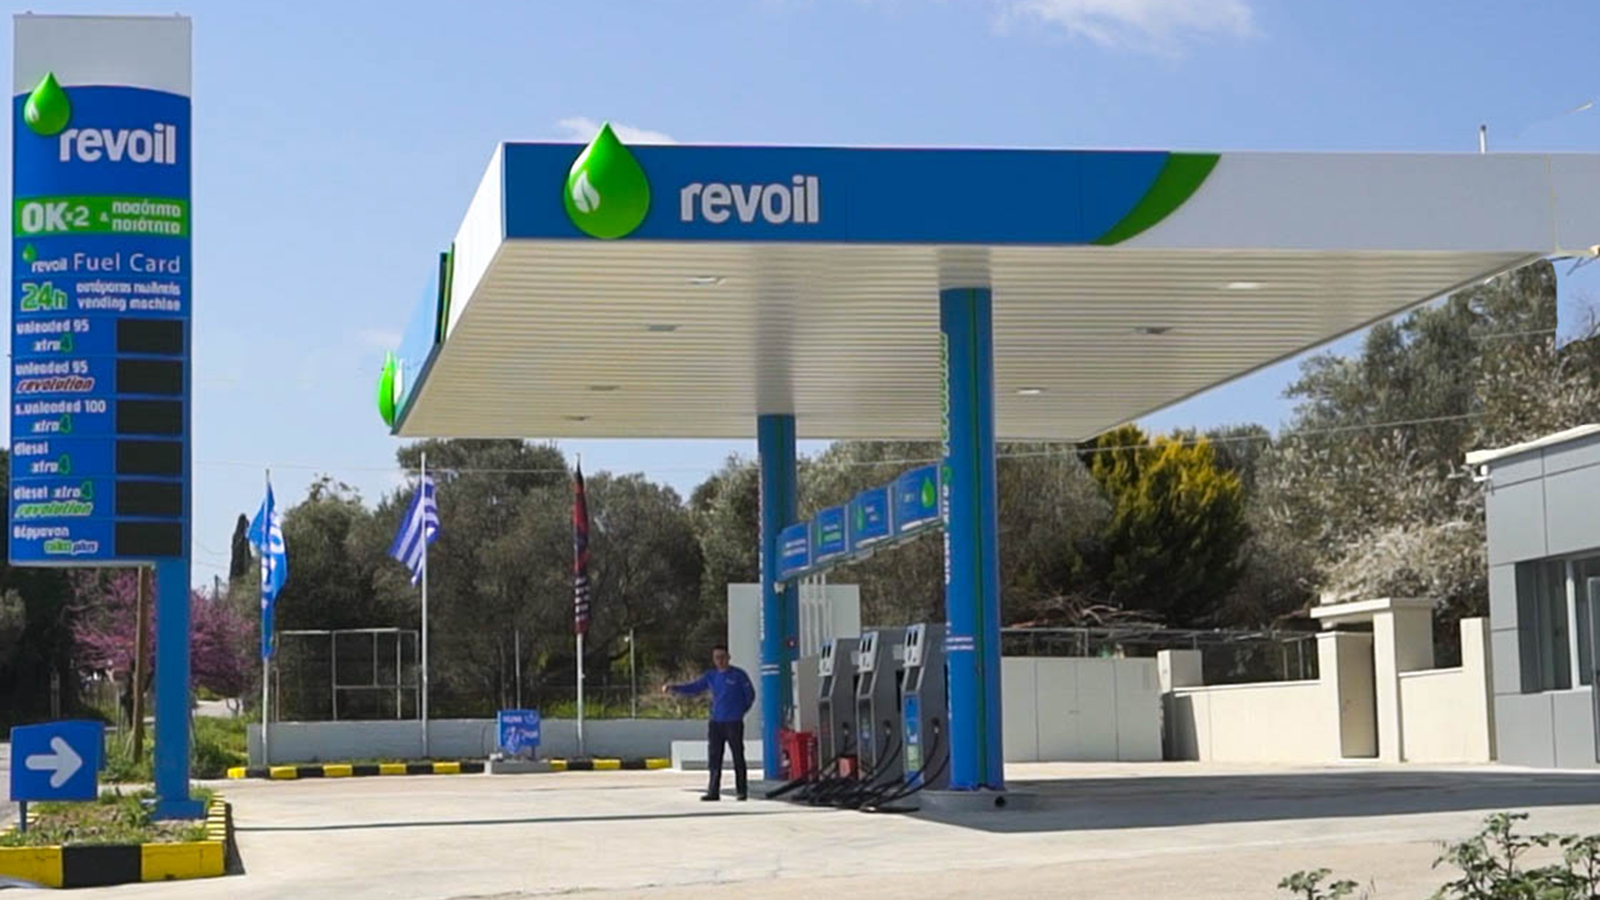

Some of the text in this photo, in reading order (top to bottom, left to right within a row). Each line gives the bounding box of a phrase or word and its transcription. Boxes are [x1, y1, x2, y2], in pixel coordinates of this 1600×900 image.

[59, 123, 176, 164] revoil
[680, 174, 819, 223] revoil
[31, 252, 181, 273] revoil Fuel Card
[20, 282, 68, 312] 24h
[77, 297, 181, 312] vending machine
[16, 319, 90, 334] unleaded 95
[15, 360, 89, 376] unleaded 95
[16, 376, 95, 394] revolution
[84, 400, 107, 413] 100
[14, 441, 48, 456] diesel
[14, 486, 48, 500] diesel
[14, 501, 94, 518] revolution
